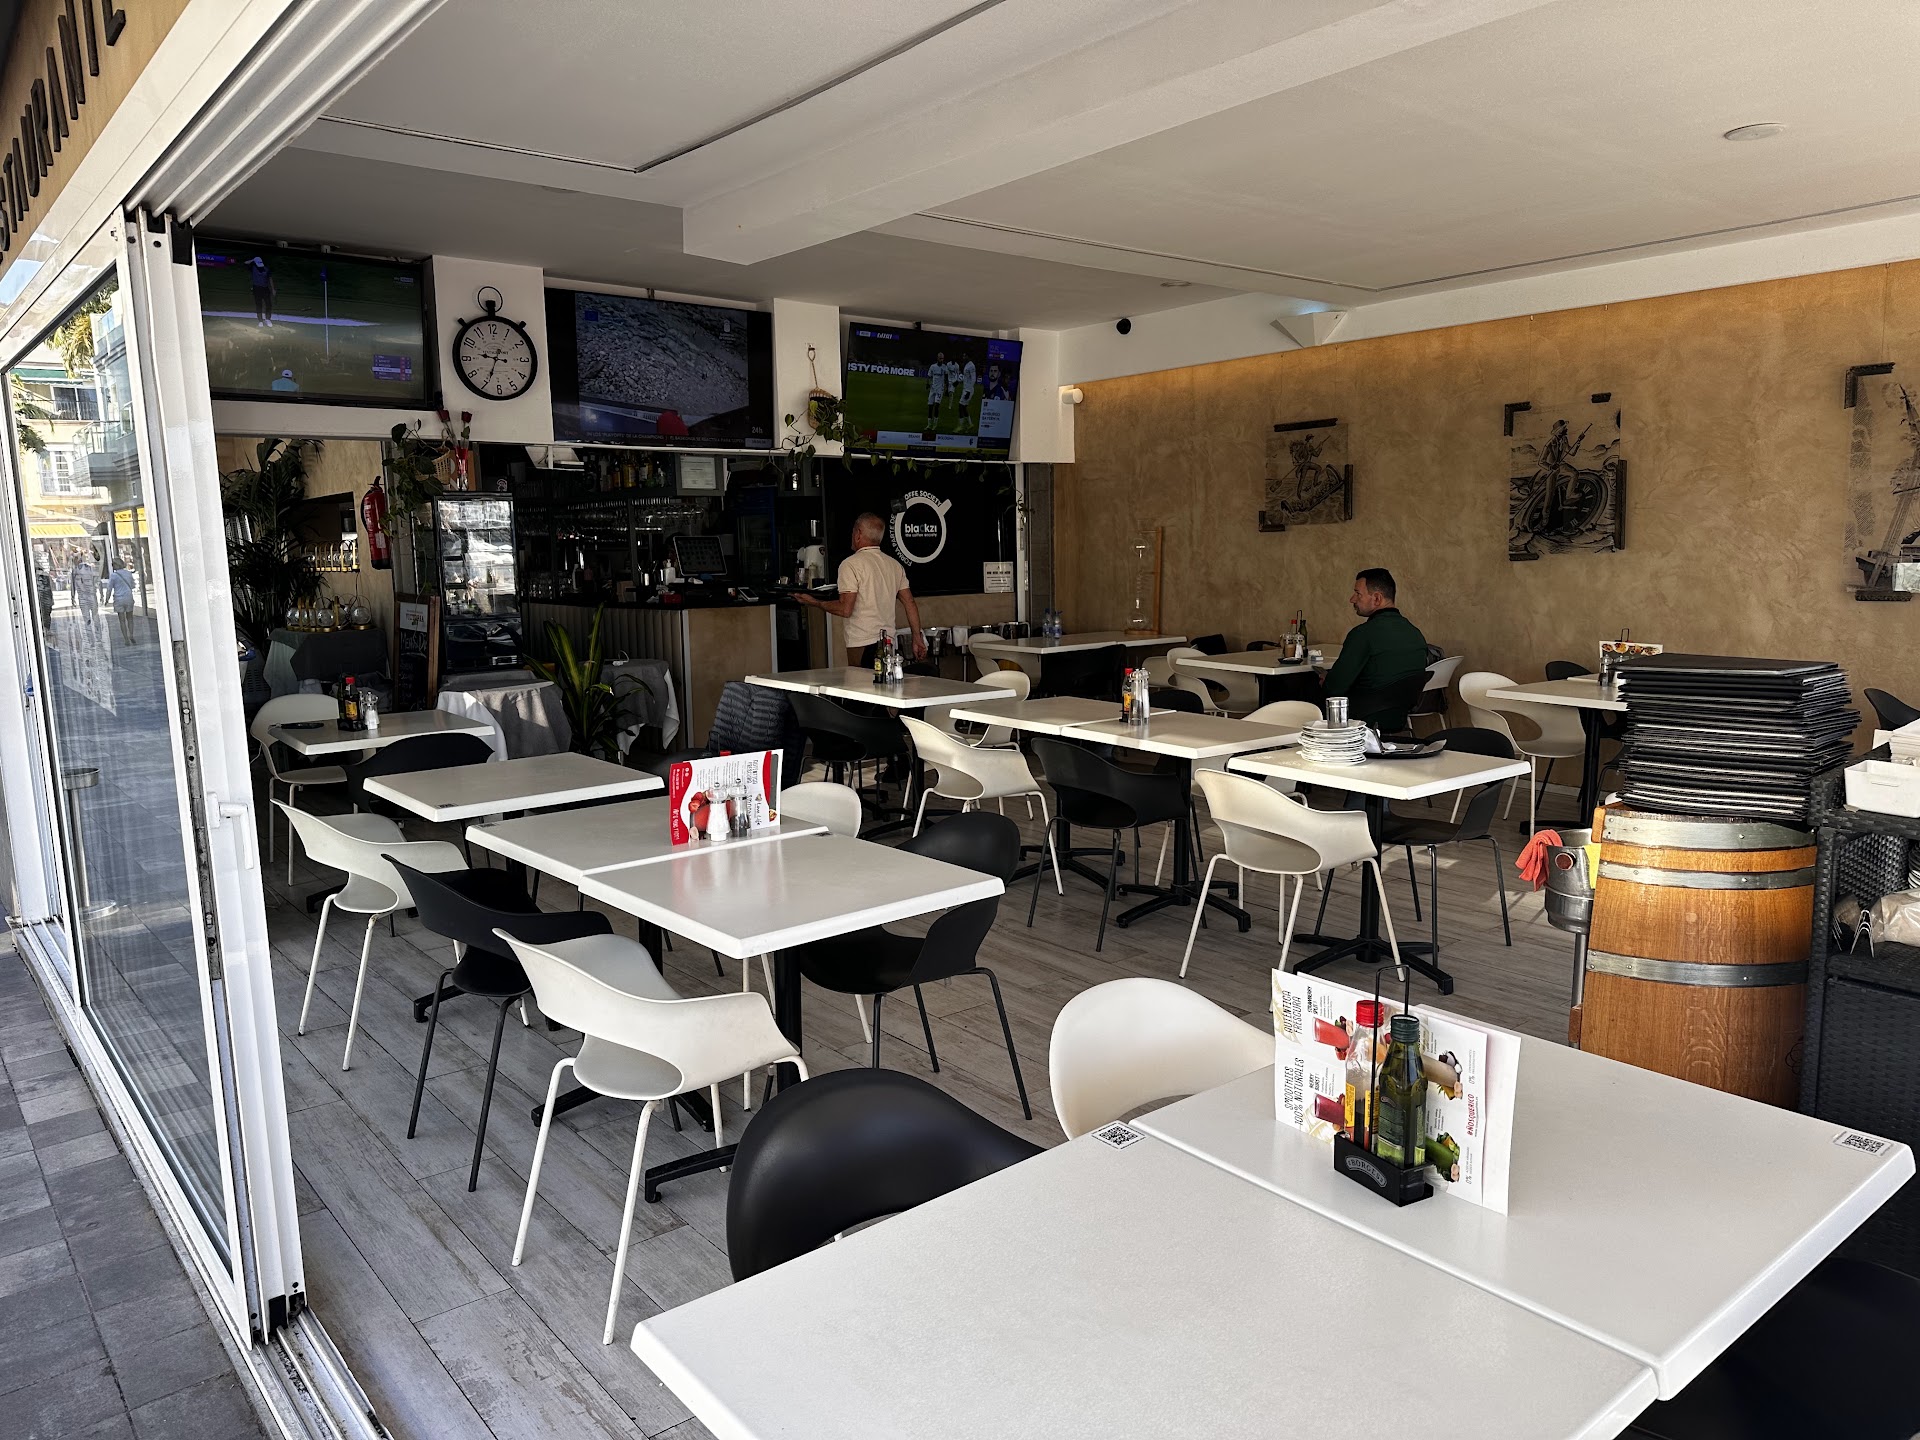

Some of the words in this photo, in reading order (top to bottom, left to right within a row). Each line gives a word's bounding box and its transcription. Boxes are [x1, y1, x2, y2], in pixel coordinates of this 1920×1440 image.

[0, 0, 126, 264] STAURANT
[474, 326, 484, 338] 11
[488, 324, 497, 335] 12
[504, 328, 510, 338] 1
[463, 337, 476, 349] 10
[514, 340, 524, 349] 2
[468, 370, 477, 378] 8
[518, 371, 527, 380] 4
[871, 365, 889, 374] FOR
[890, 367, 916, 376] MORE
[481, 380, 489, 389] 7
[496, 384, 503, 395] 6
[509, 380, 518, 391] 5
[904, 490, 919, 500] OFFE
[919, 490, 942, 507] SOCIETY
[889, 524, 898, 547] PARTE
[895, 547, 913, 567] FORMA
[1281, 990, 1293, 1033] AUTÉNTICA
[1292, 996, 1303, 1034] FRESCURA
[1294, 1058, 1304, 1102] NATURALES
[1468, 1075, 1475, 1084] 0%
[1284, 1066, 1294, 1110] SMOOTHIES
[1294, 1104, 1304, 1126] 100%
[1466, 1094, 1476, 1136] #ÑOSQUERICO
[1350, 1158, 1382, 1180] BORGES
[1465, 1175, 1472, 1185] 0%
